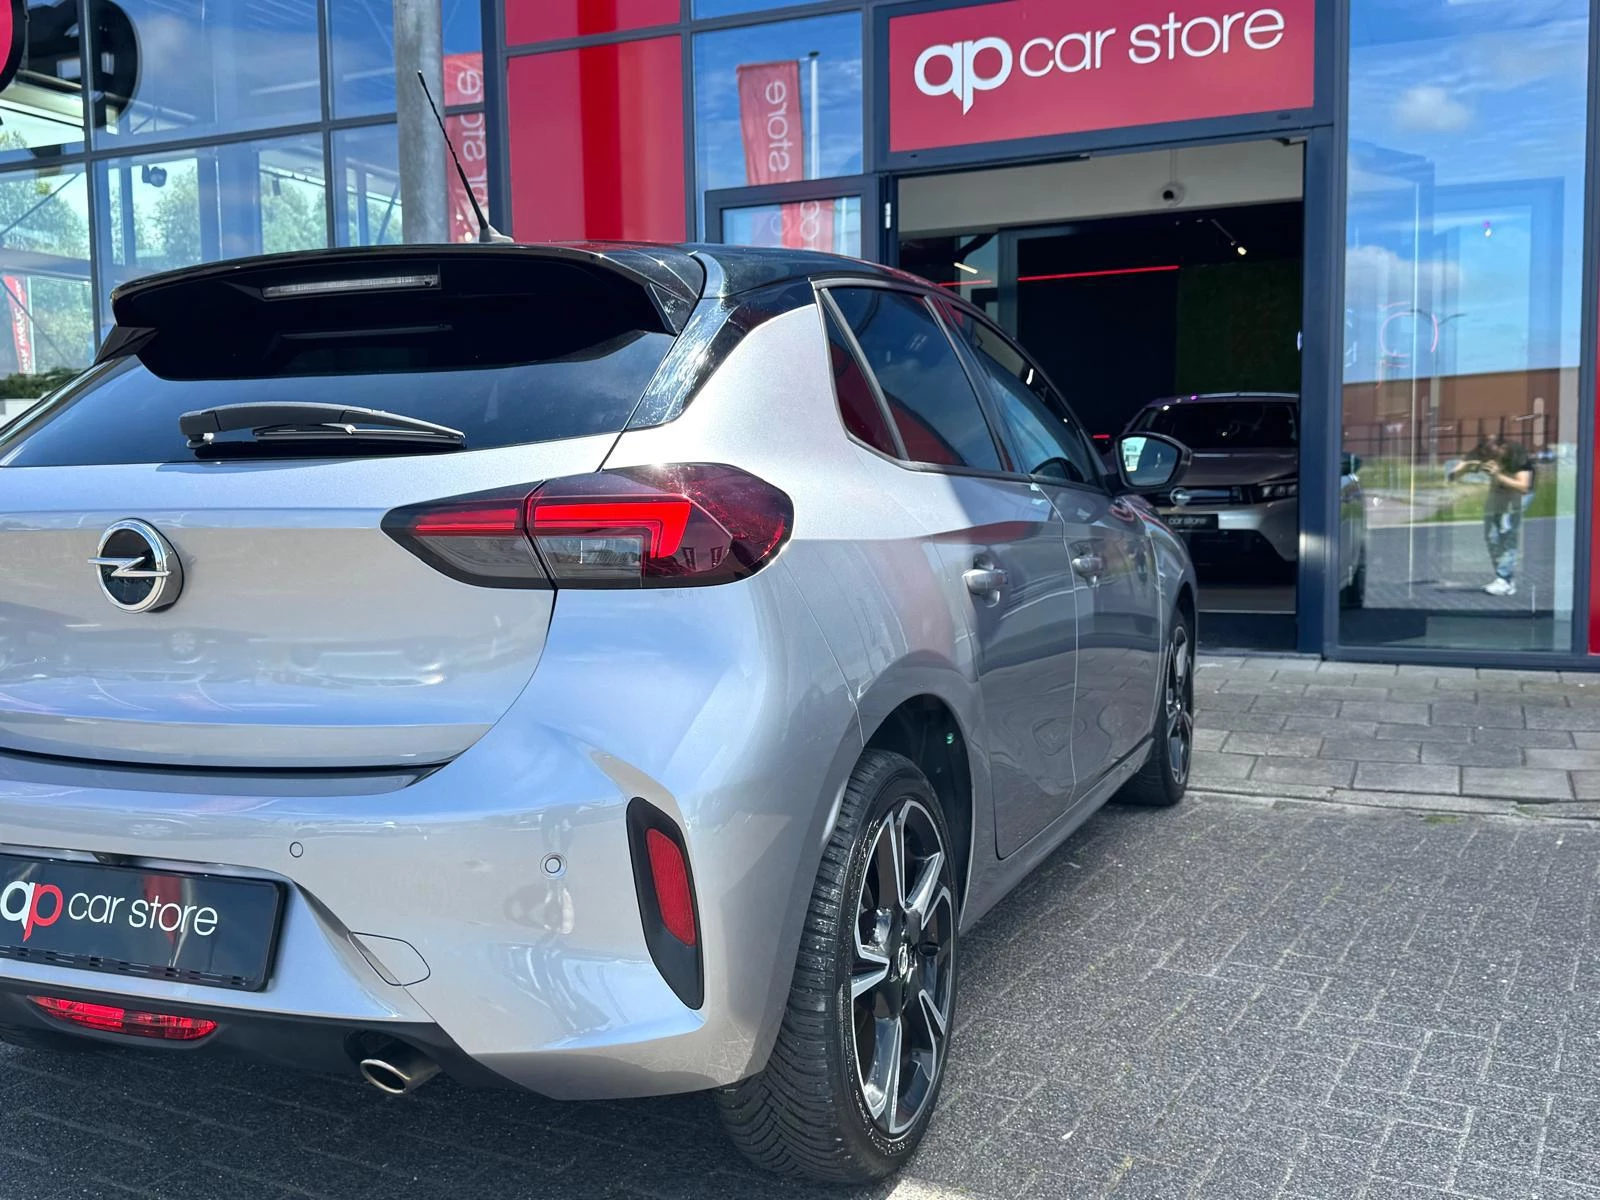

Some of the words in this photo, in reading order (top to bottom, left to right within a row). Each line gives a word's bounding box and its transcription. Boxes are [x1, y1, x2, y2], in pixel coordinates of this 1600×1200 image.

[1019, 28, 1117, 77] car
[1128, 8, 1285, 65] store
[68, 892, 125, 924] car
[128, 895, 218, 936] store
